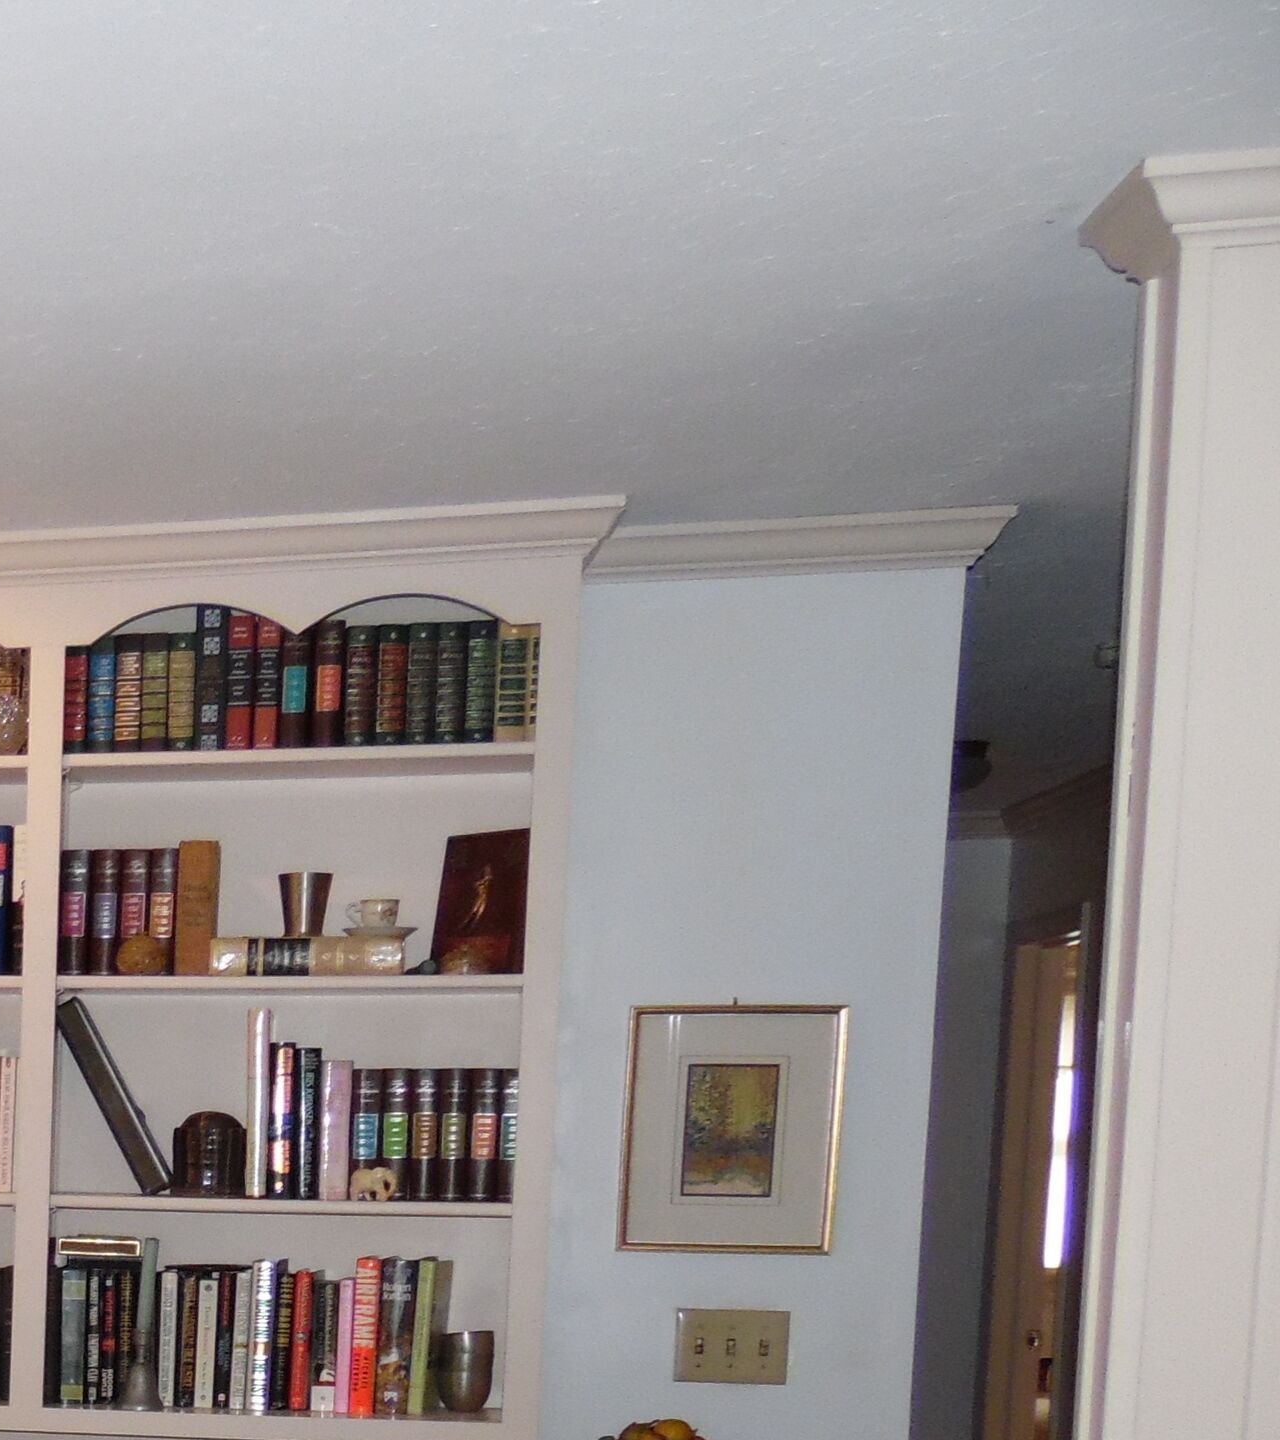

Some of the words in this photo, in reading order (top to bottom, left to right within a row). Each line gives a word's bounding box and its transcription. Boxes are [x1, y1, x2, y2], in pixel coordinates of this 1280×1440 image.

[120, 1275, 131, 1306] SIDNEY
[280, 1276, 294, 1304] STEVE
[353, 1268, 378, 1349] AIRFRAME
[120, 1310, 130, 1351] SHELDON
[277, 1308, 291, 1347] MARTINI
[360, 1356, 369, 1390] MICHAEL
